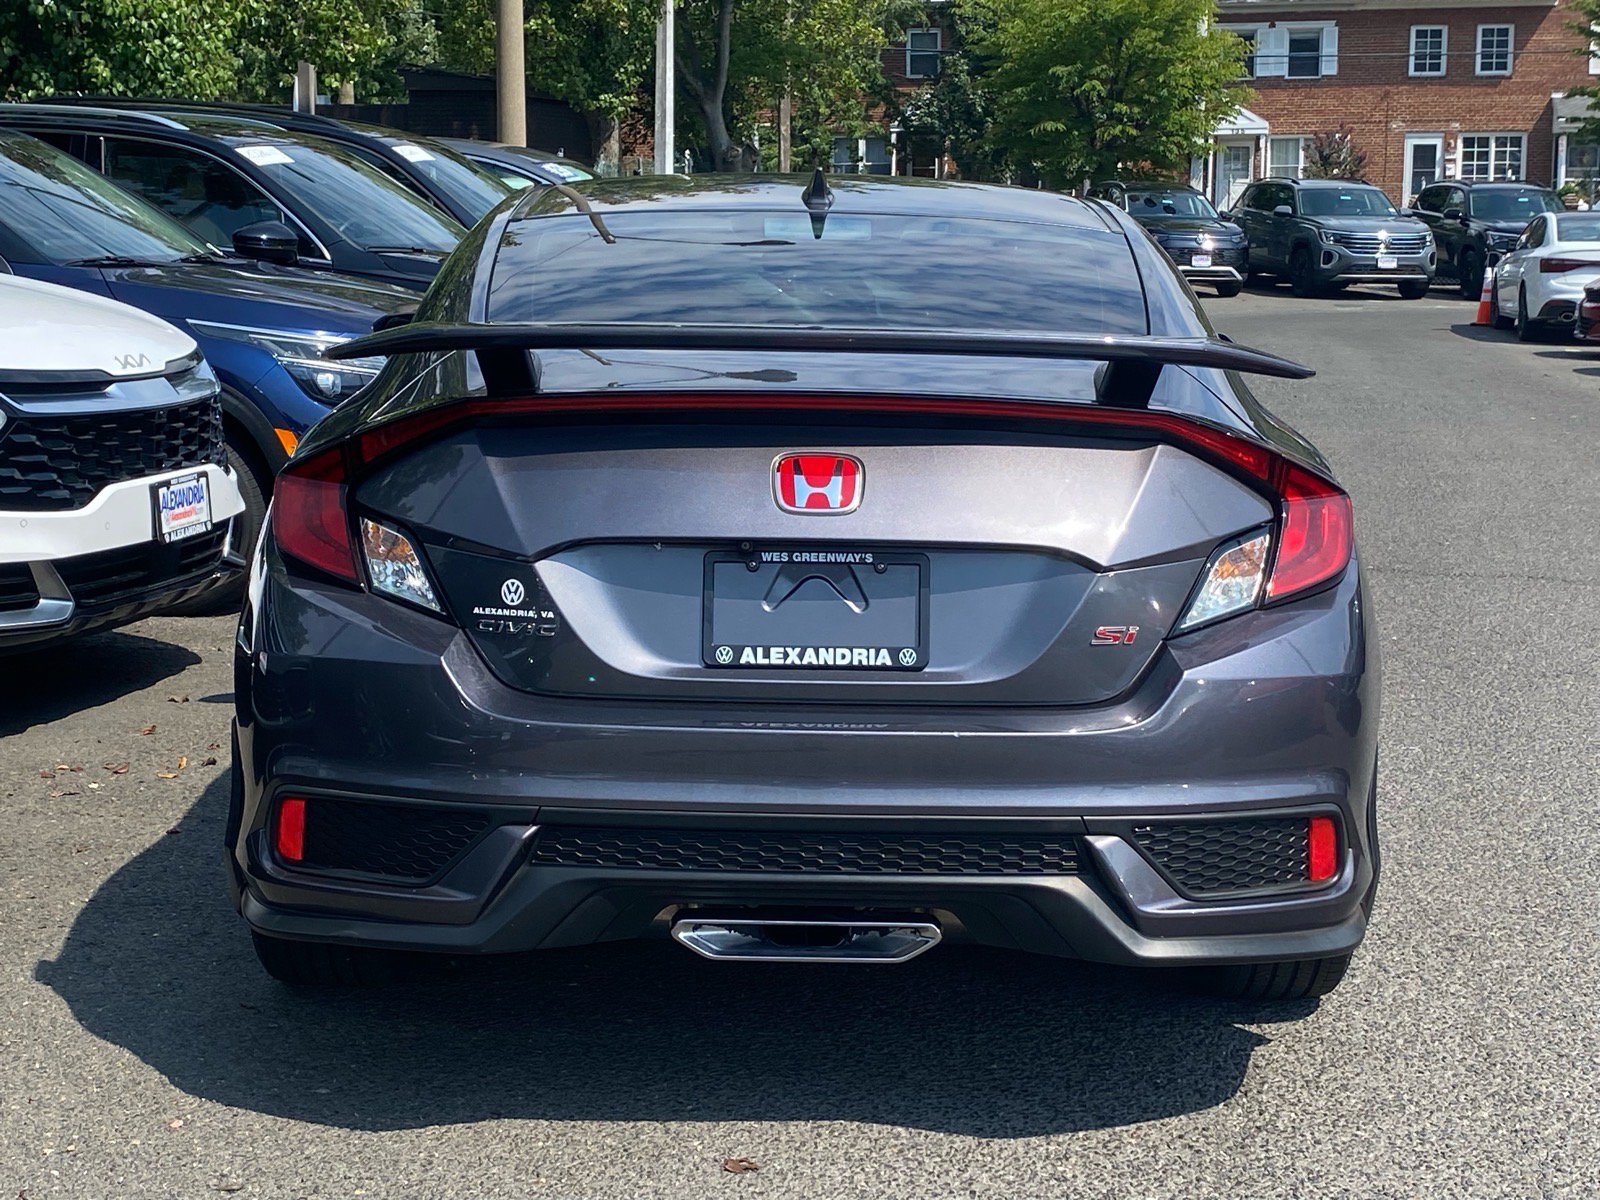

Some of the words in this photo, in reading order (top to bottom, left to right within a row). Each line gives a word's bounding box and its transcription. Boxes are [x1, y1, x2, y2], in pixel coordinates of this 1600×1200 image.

[761, 552, 788, 562] WES
[793, 553, 873, 563] GREENWAY'S
[541, 610, 555, 618] VA
[477, 619, 556, 637] CIVIC
[1091, 625, 1140, 645] Si
[740, 647, 892, 666] ALEXANDRIA
